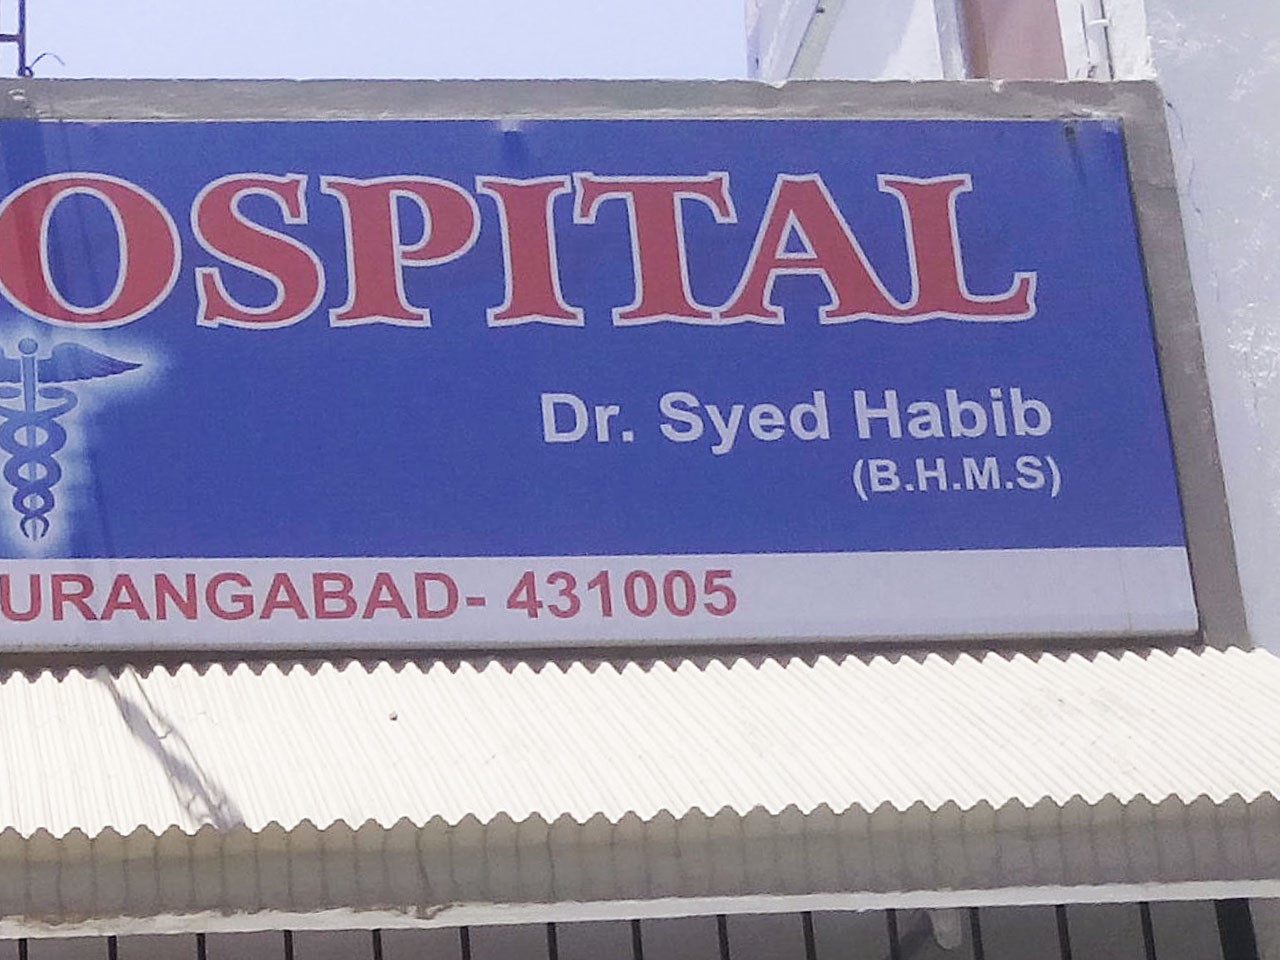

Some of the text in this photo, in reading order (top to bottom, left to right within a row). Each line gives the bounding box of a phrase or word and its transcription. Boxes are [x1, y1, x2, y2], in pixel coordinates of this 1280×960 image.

[541, 388, 1052, 454] Dr. Syed Habib
[852, 456, 1062, 501] (B.H.M.S)
[507, 569, 738, 619] 431005
